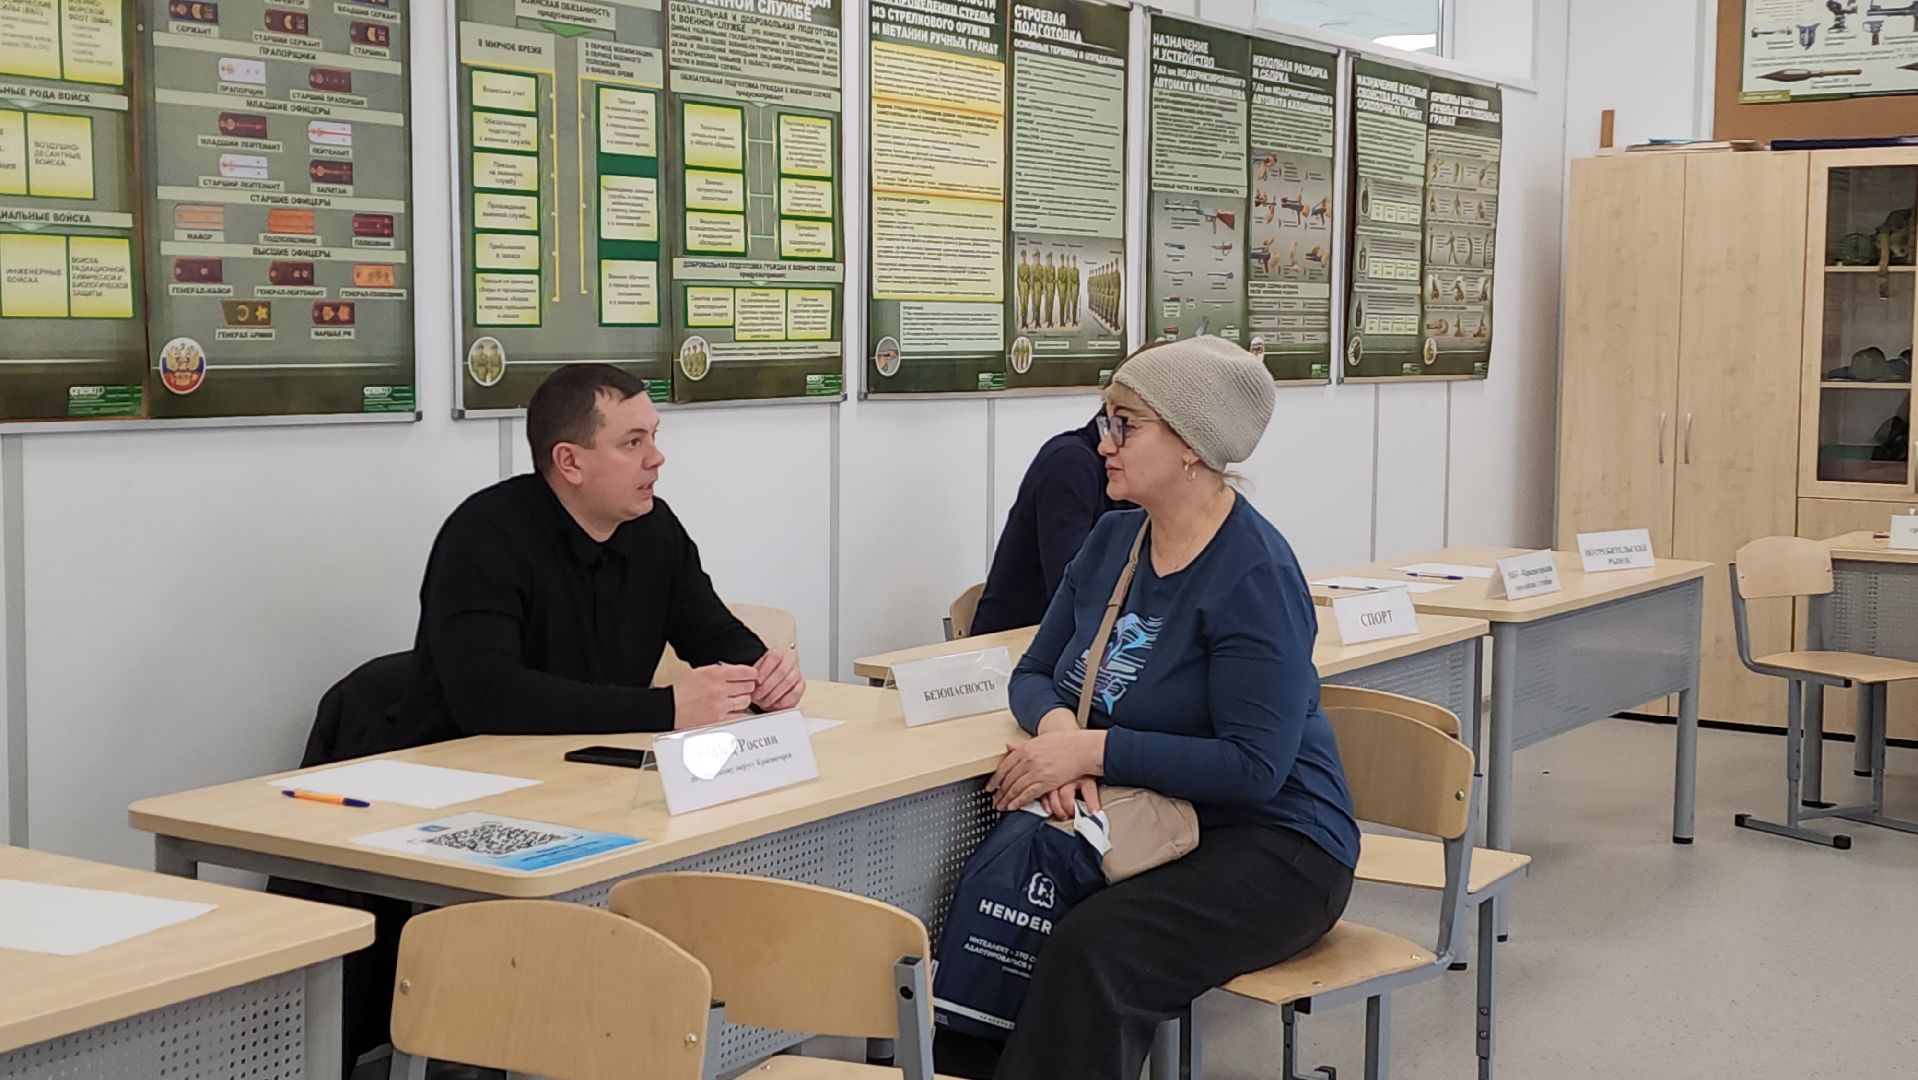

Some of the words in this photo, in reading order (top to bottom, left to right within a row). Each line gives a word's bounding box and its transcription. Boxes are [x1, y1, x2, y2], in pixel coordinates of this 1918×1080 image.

[757, 0, 813, 22] СЛУЖБЕ
[959, 6, 996, 24] СТРЕЛЬБ
[1014, 4, 1067, 27] СТРОЕВАЯ
[670, 4, 728, 21] ОБЯЗАТЕЛЬНАЯ
[740, 15, 795, 31] ДОБРОВОЛЬНАЯ
[797, 24, 838, 39] ПОДГОТОВКА
[678, 16, 714, 28] ВОЕННОЙ
[716, 21, 746, 34] СЛУЖБЕ
[872, 5, 886, 19] ИЗ
[888, 8, 955, 32] СТРЕЛКОВОГО
[956, 20, 991, 39] ОРУЖИЯ
[872, 21, 880, 34] И
[882, 23, 928, 43] МЕТАНИИ
[929, 31, 968, 50] РУЧНЫХ
[967, 38, 1000, 56] ГРАНАТ
[1014, 19, 1083, 43] ПОДГОТОВКА
[485, 39, 516, 52] МИРНОЕ
[517, 44, 543, 56] ВРЕМЯ
[1153, 32, 1209, 55] НАЗНАЧЕНИЕ
[259, 47, 317, 60] ПРАПОРЩИКИ
[1152, 46, 1160, 60] И
[1161, 48, 1215, 69] УСТРОЙСТВО
[29, 89, 56, 99] РОДА
[246, 100, 288, 112] МЛАДШИЕ
[290, 104, 331, 116] ОФИЦЕРЫ
[250, 195, 289, 205] СТАРШИЕ
[291, 197, 331, 207] ОФИЦЕРЫ
[0, 211, 50, 221] ИАЛЬНЫЕ
[53, 213, 92, 223] ВОЙСКА
[253, 246, 289, 257] ВЫСШИЕ
[291, 248, 331, 258] ОФИЦЕРЫ
[1360, 609, 1393, 627] СПОРТ
[924, 679, 995, 702] БЕЗОПАСНОСТЬ
[738, 734, 779, 752] России
[979, 898, 1053, 935] HENDER
